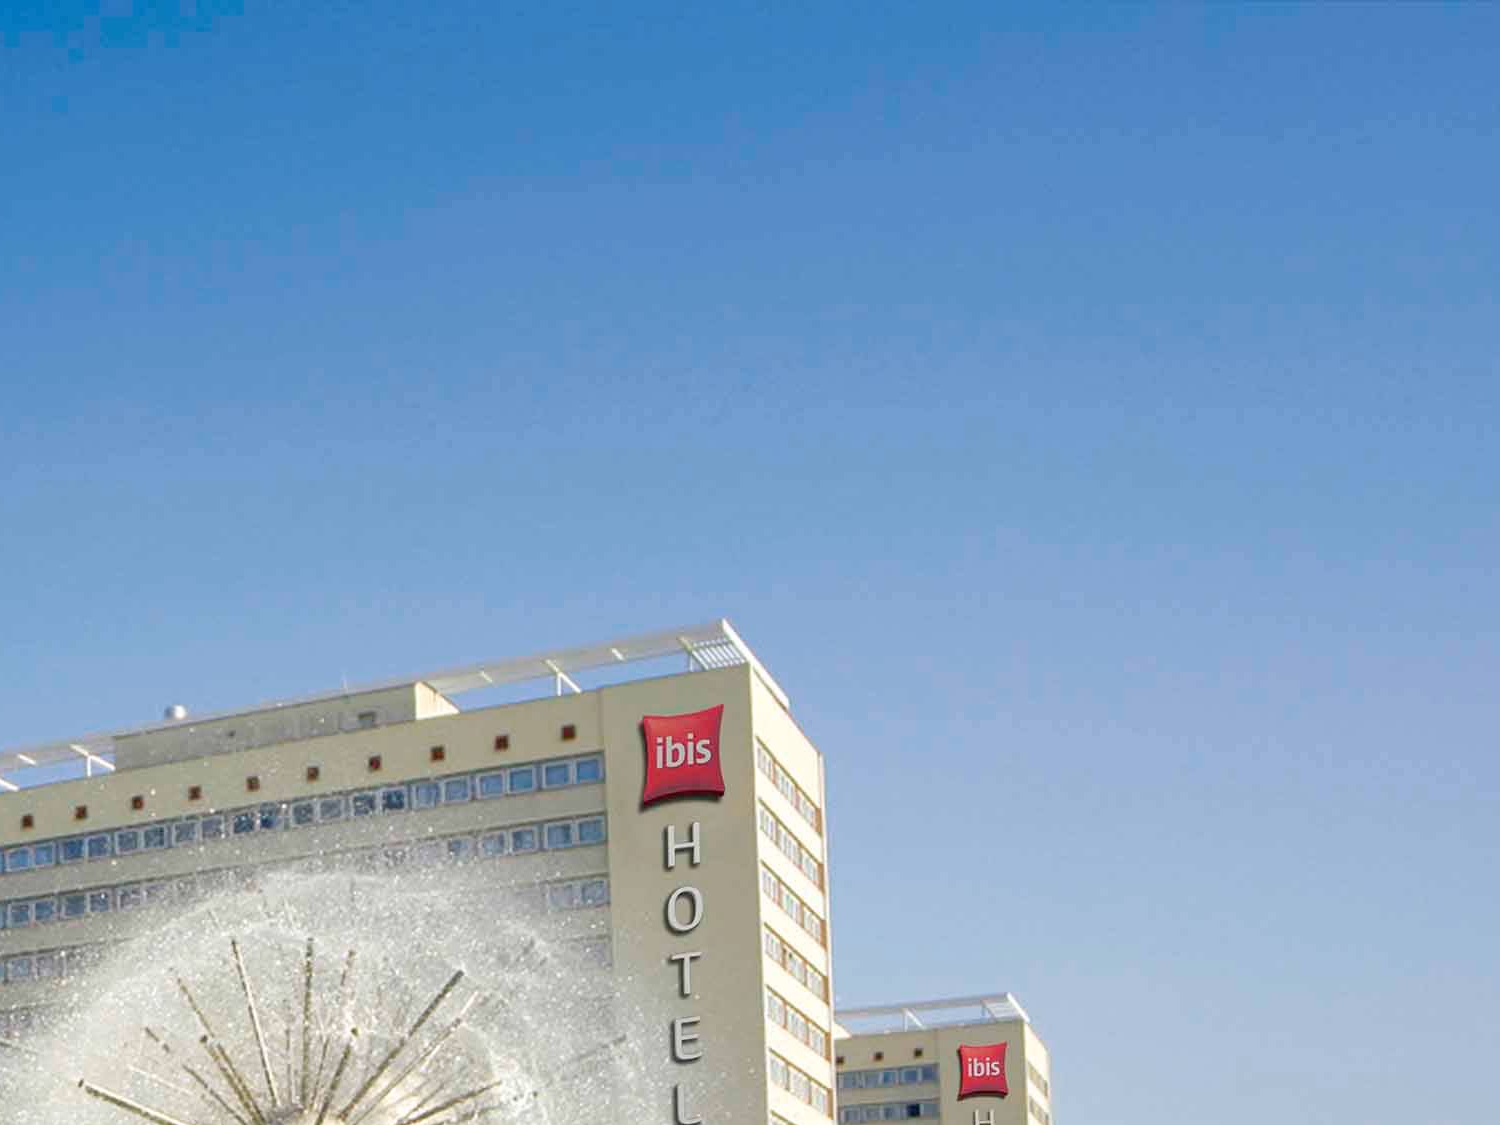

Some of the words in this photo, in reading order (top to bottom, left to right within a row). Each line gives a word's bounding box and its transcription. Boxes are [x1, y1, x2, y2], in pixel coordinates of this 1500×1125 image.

[655, 733, 713, 770] ibis
[664, 820, 705, 1125] HOTEL
[967, 1057, 1001, 1078] ibis
